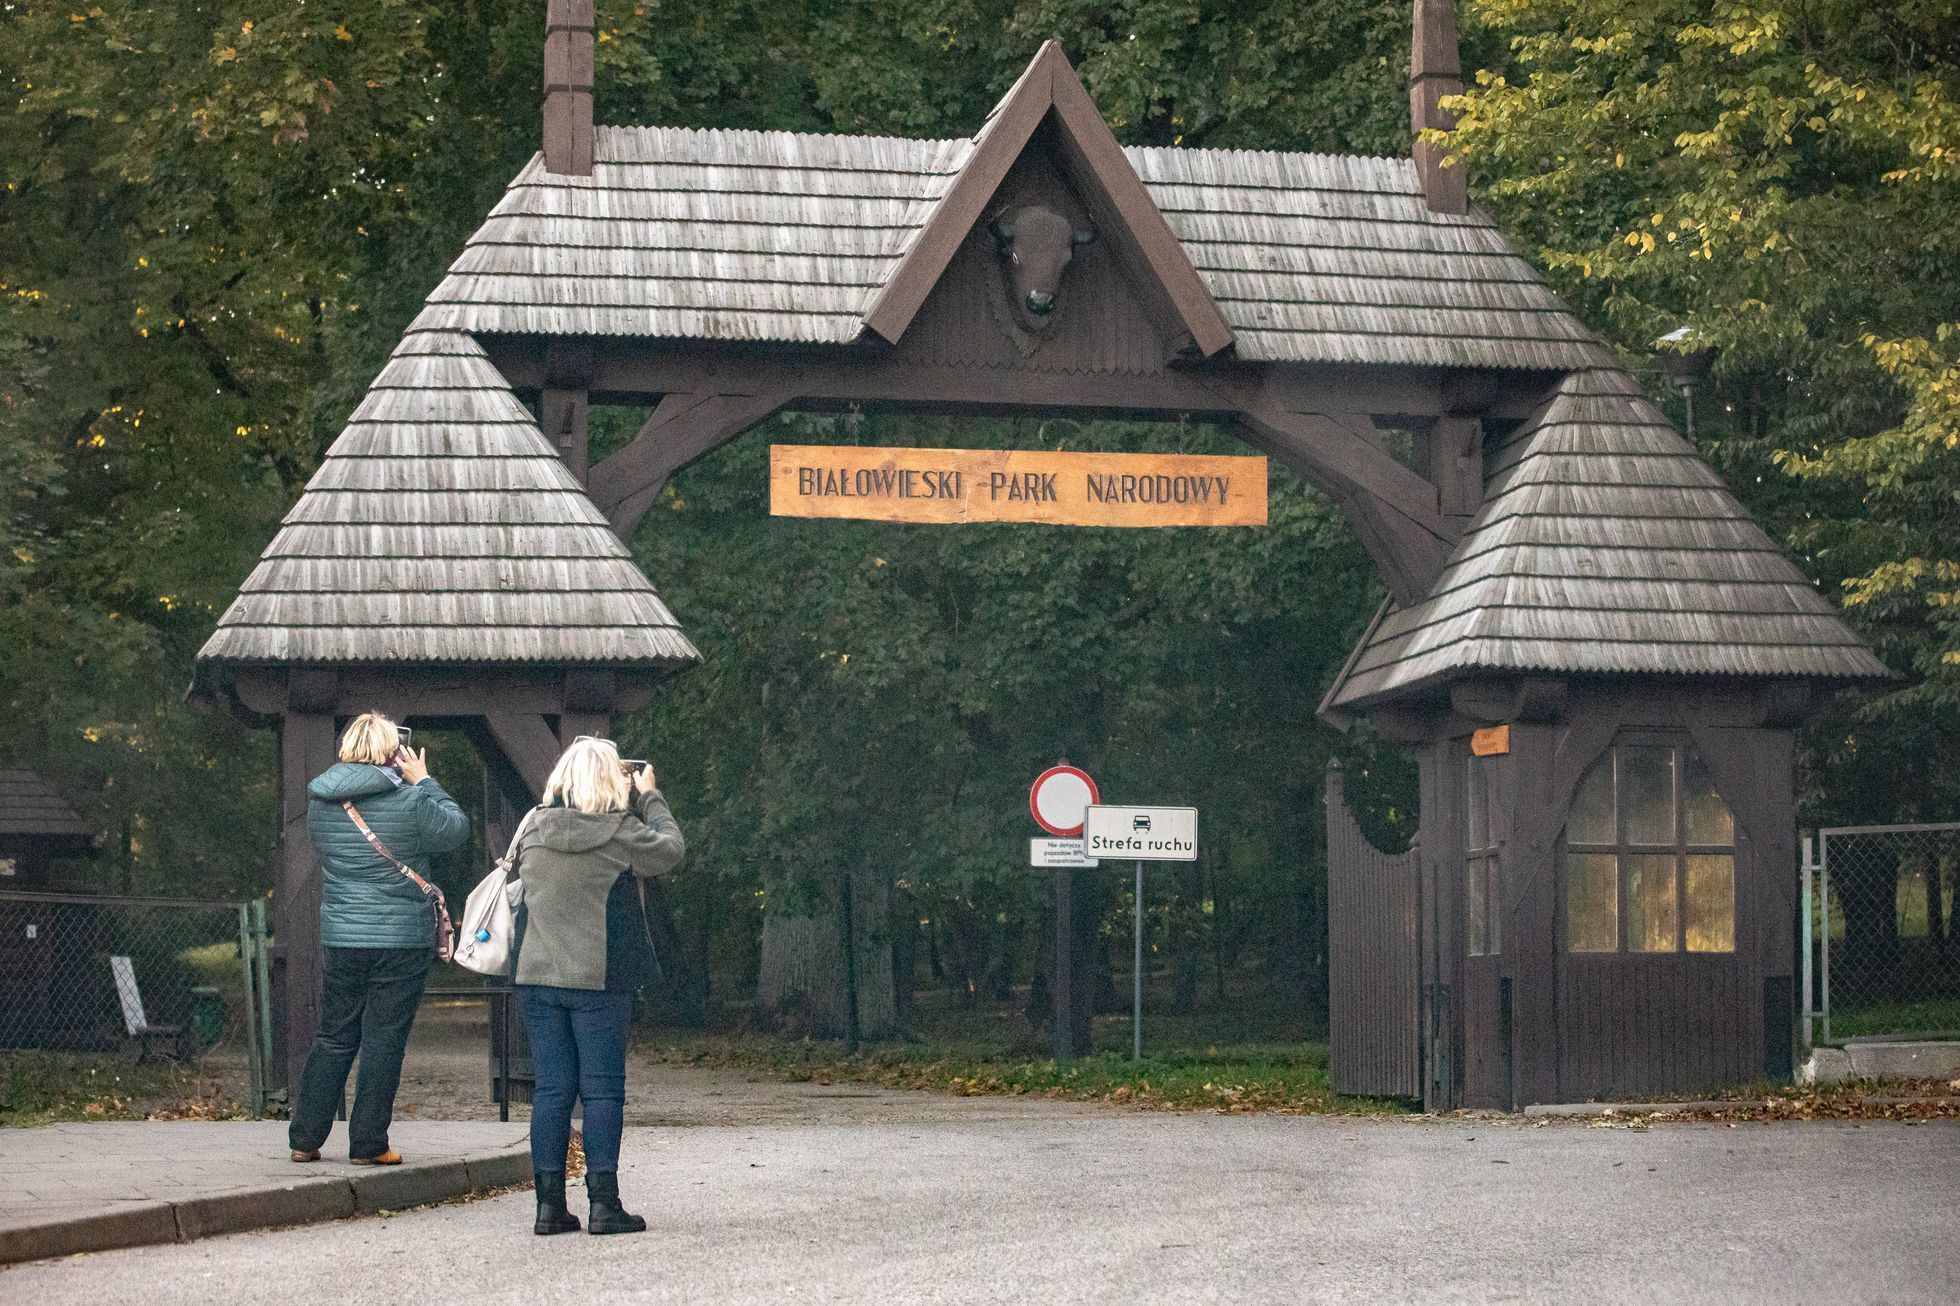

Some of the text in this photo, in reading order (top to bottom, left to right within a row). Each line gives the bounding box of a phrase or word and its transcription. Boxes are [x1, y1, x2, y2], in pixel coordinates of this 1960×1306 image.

[799, 466, 1231, 506] BIAŁOWIESKI PARK NARODOWY
[1092, 835, 1192, 851] Strefa ruchu
